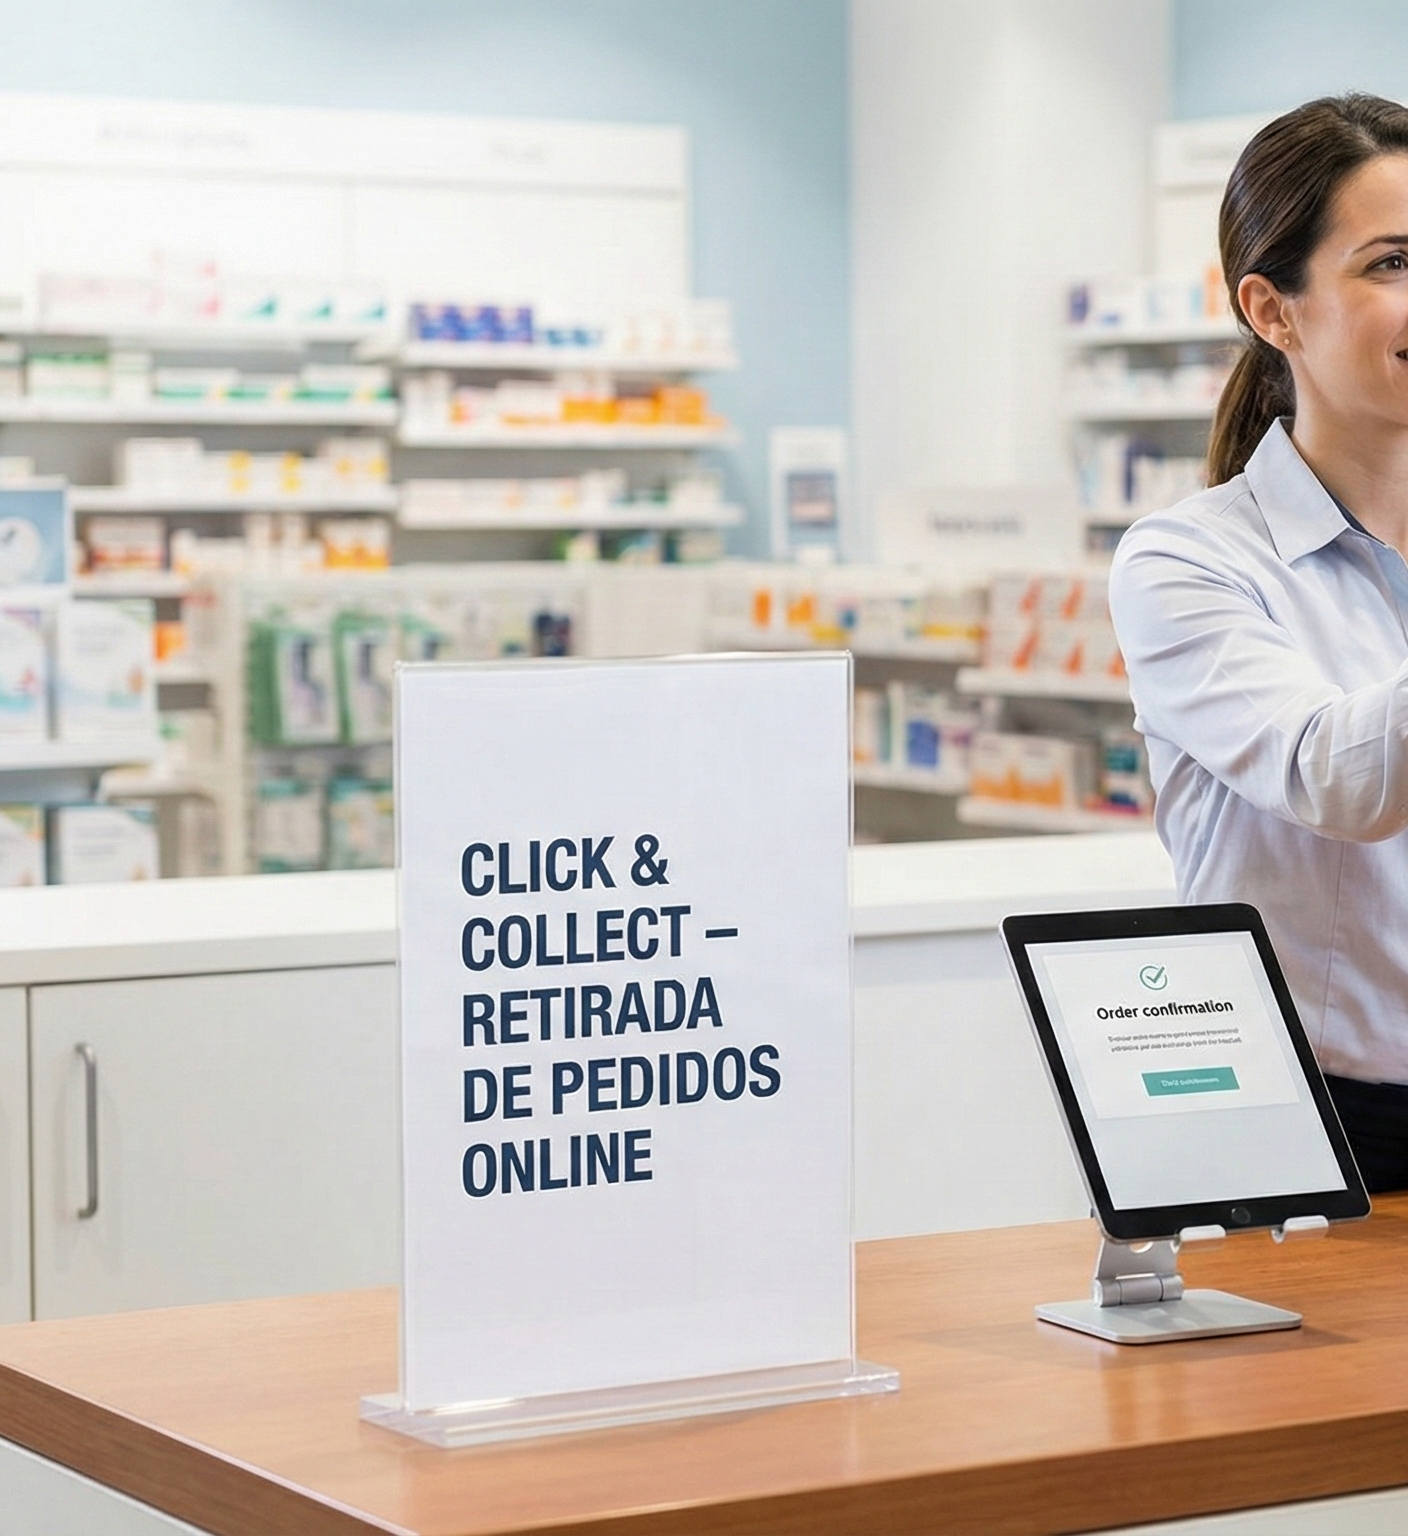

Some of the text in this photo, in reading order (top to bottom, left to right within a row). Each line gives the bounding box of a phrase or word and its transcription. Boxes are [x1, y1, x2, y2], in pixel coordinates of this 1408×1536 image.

[462, 833, 670, 897] CLICK &
[461, 905, 691, 972] COLLECT
[463, 976, 723, 1047] RETIRADA
[1096, 999, 1234, 1020] Order confirmation
[463, 1044, 781, 1123] DE PEDIDOS
[462, 1128, 653, 1198] ONLINE
